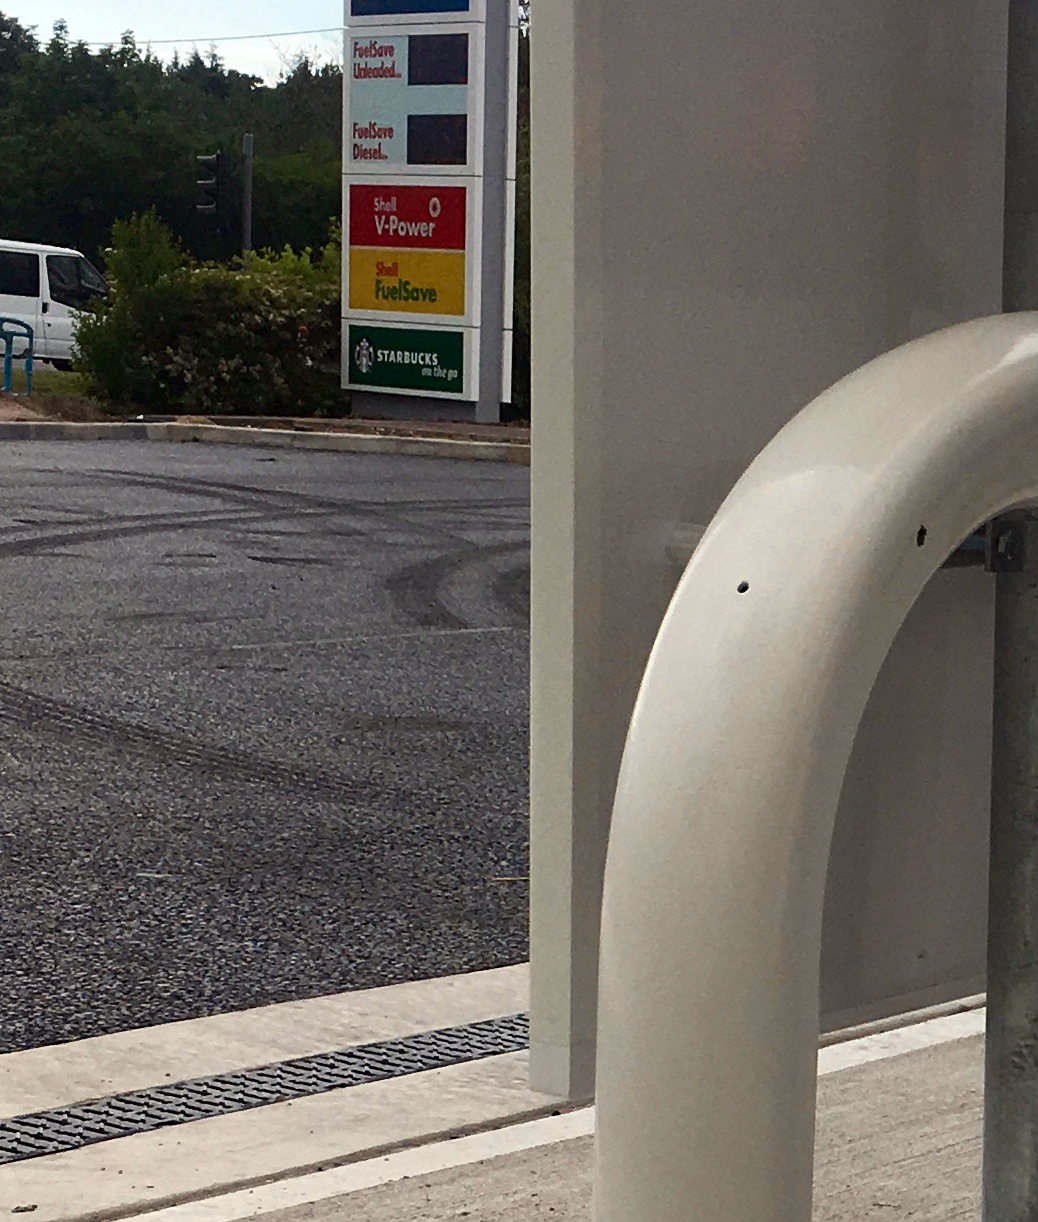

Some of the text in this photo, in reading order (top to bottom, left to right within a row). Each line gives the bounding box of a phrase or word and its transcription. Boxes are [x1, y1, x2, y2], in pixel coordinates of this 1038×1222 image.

[353, 41, 395, 58] FuelSave
[353, 61, 395, 79] Unleaded
[353, 121, 394, 139] FuelSave
[353, 142, 382, 160] Diesel
[374, 197, 397, 212] Shell
[374, 215, 436, 237] V-Power
[375, 260, 399, 277] Shell
[374, 278, 437, 302] FuelSave
[377, 349, 438, 366] STARBUCKS
[421, 365, 458, 380] on the go
